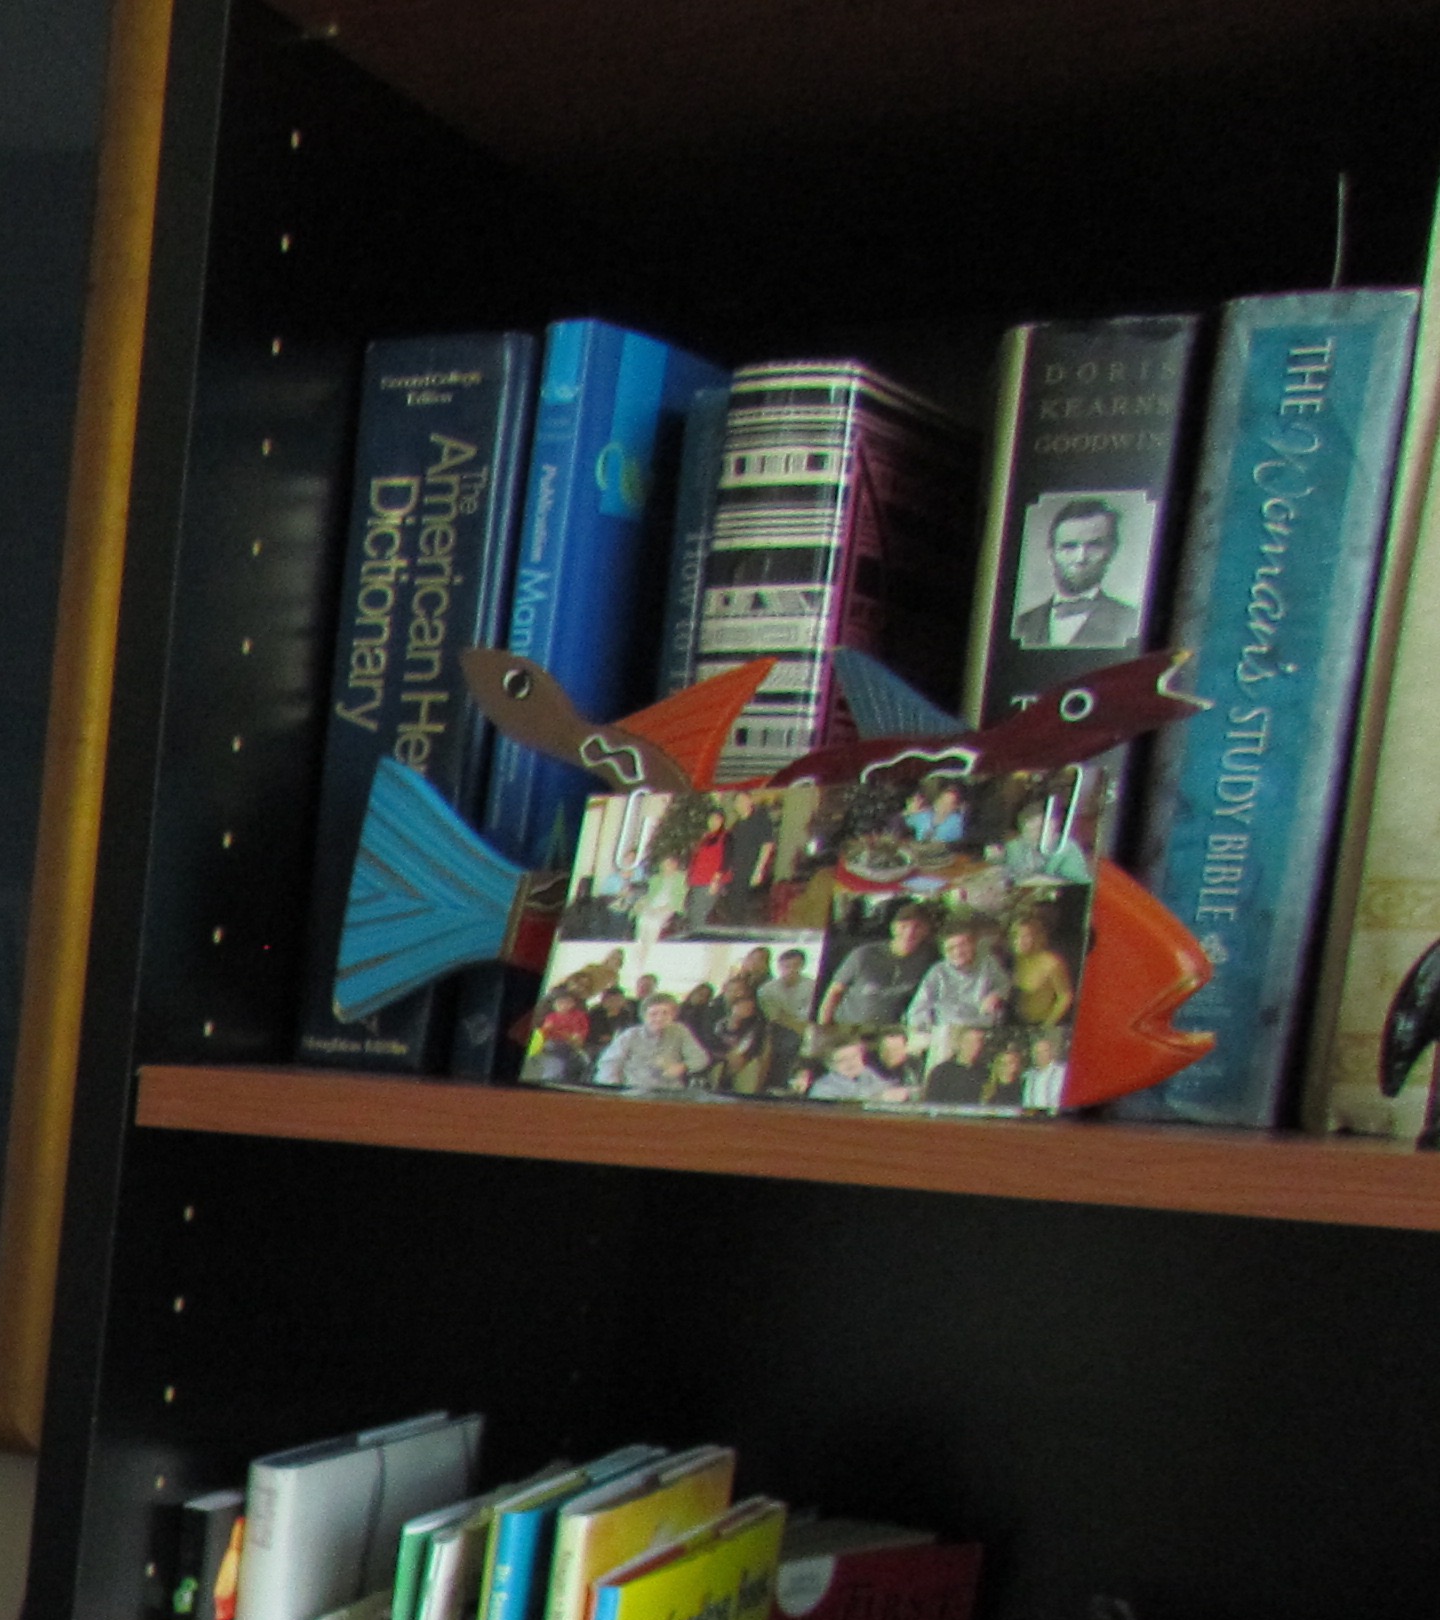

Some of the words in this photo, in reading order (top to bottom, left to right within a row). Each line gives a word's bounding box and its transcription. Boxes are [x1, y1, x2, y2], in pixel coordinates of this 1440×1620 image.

[1039, 391, 1174, 419] KEARNS
[1043, 359, 1177, 384] DORIS
[1279, 338, 1334, 416] THE
[1033, 428, 1168, 454] GOODWIN
[460, 464, 489, 515] The
[403, 432, 478, 683] American
[1235, 420, 1323, 699] Woman's
[334, 475, 420, 732] Dictionary
[1213, 706, 1271, 825] STUDY
[1195, 832, 1250, 923] BIBLE
